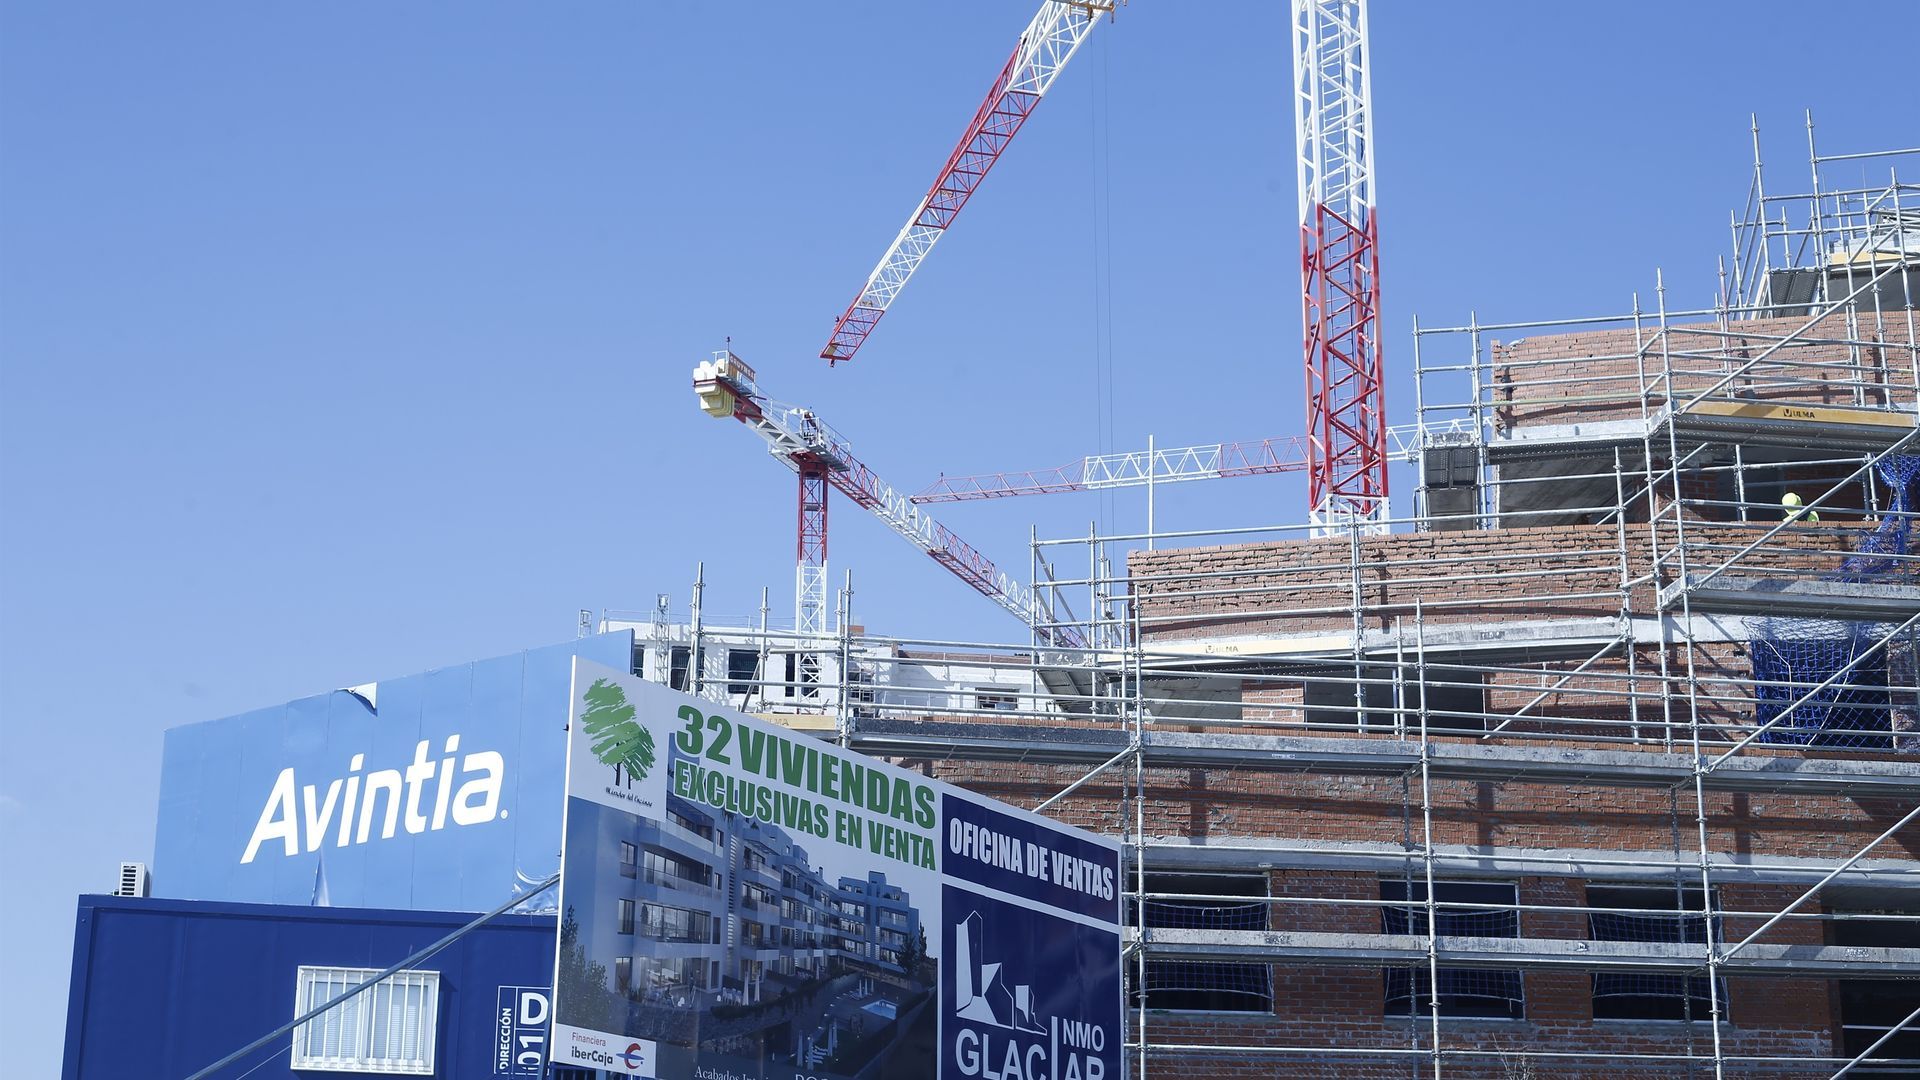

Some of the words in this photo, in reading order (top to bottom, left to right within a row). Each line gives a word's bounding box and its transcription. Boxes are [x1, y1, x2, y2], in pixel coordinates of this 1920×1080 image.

[676, 704, 733, 765] 32
[737, 723, 936, 830] VIVIENDAS
[674, 759, 830, 839] EXCLUSIVAS
[835, 810, 862, 849] EN
[868, 820, 936, 871] VENTA
[950, 817, 1024, 874] OFICINA
[1026, 842, 1049, 882] DE
[1051, 850, 1114, 901] VENTAS
[499, 1007, 512, 1070] DIRECCIÓN
[520, 992, 549, 1025] D
[571, 1031, 607, 1047] Financiera
[571, 1045, 613, 1066] iberCaja
